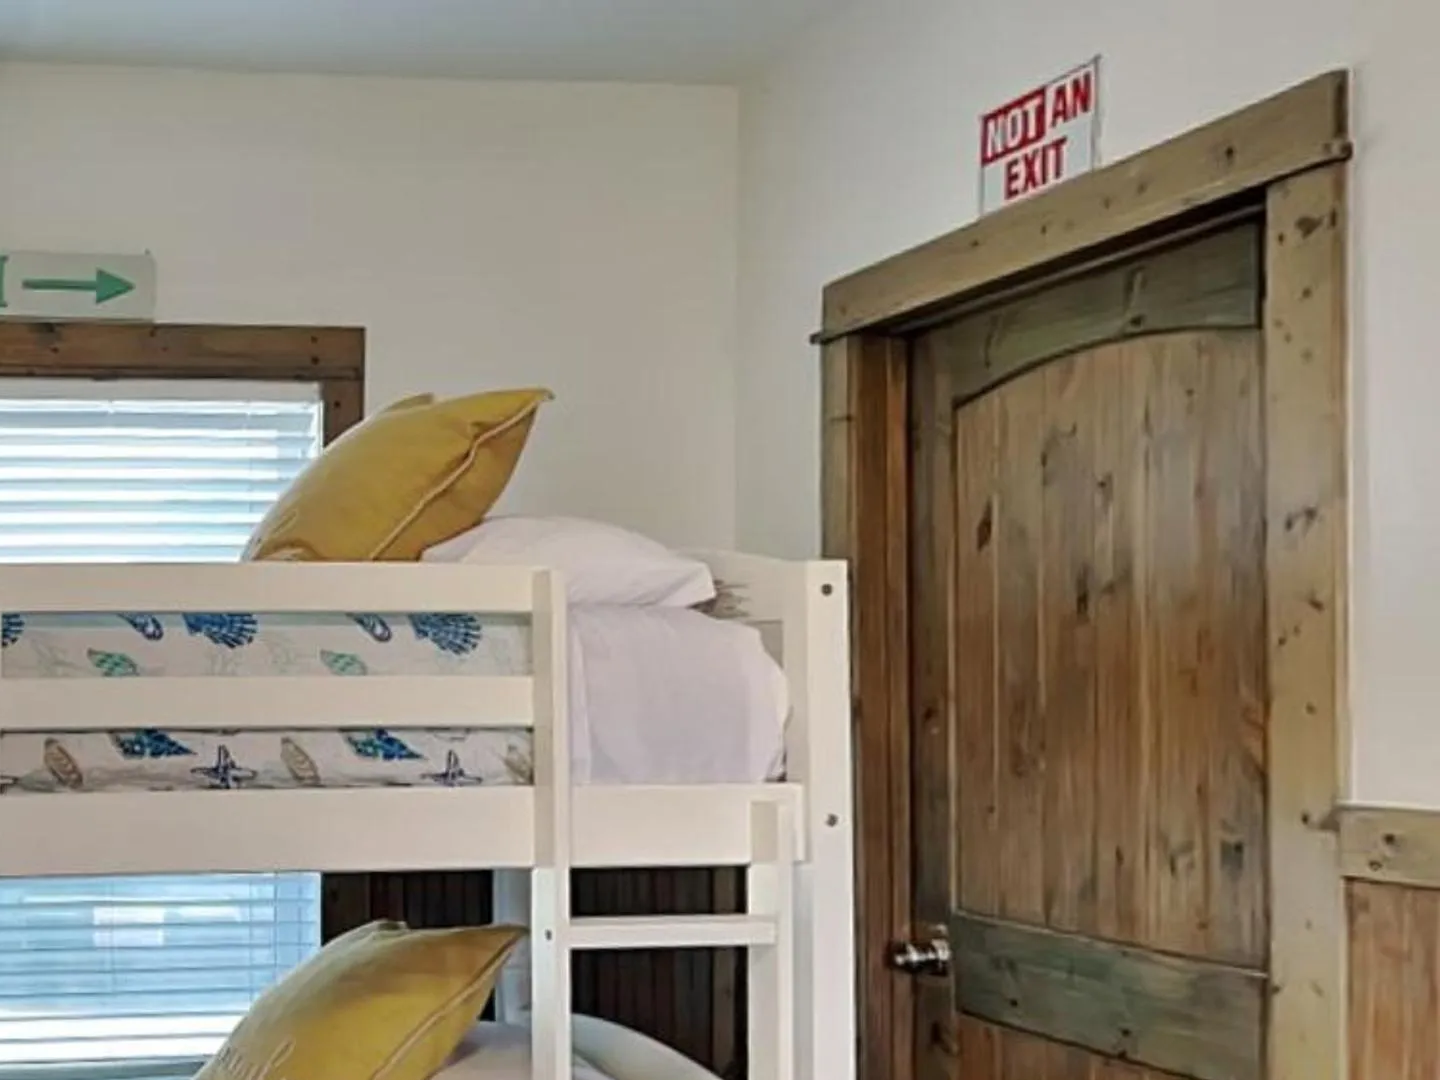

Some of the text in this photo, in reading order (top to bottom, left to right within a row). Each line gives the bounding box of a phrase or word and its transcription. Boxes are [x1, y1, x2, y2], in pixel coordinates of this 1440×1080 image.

[984, 71, 1092, 160] NOT AN
[1005, 135, 1068, 200] EXIT
